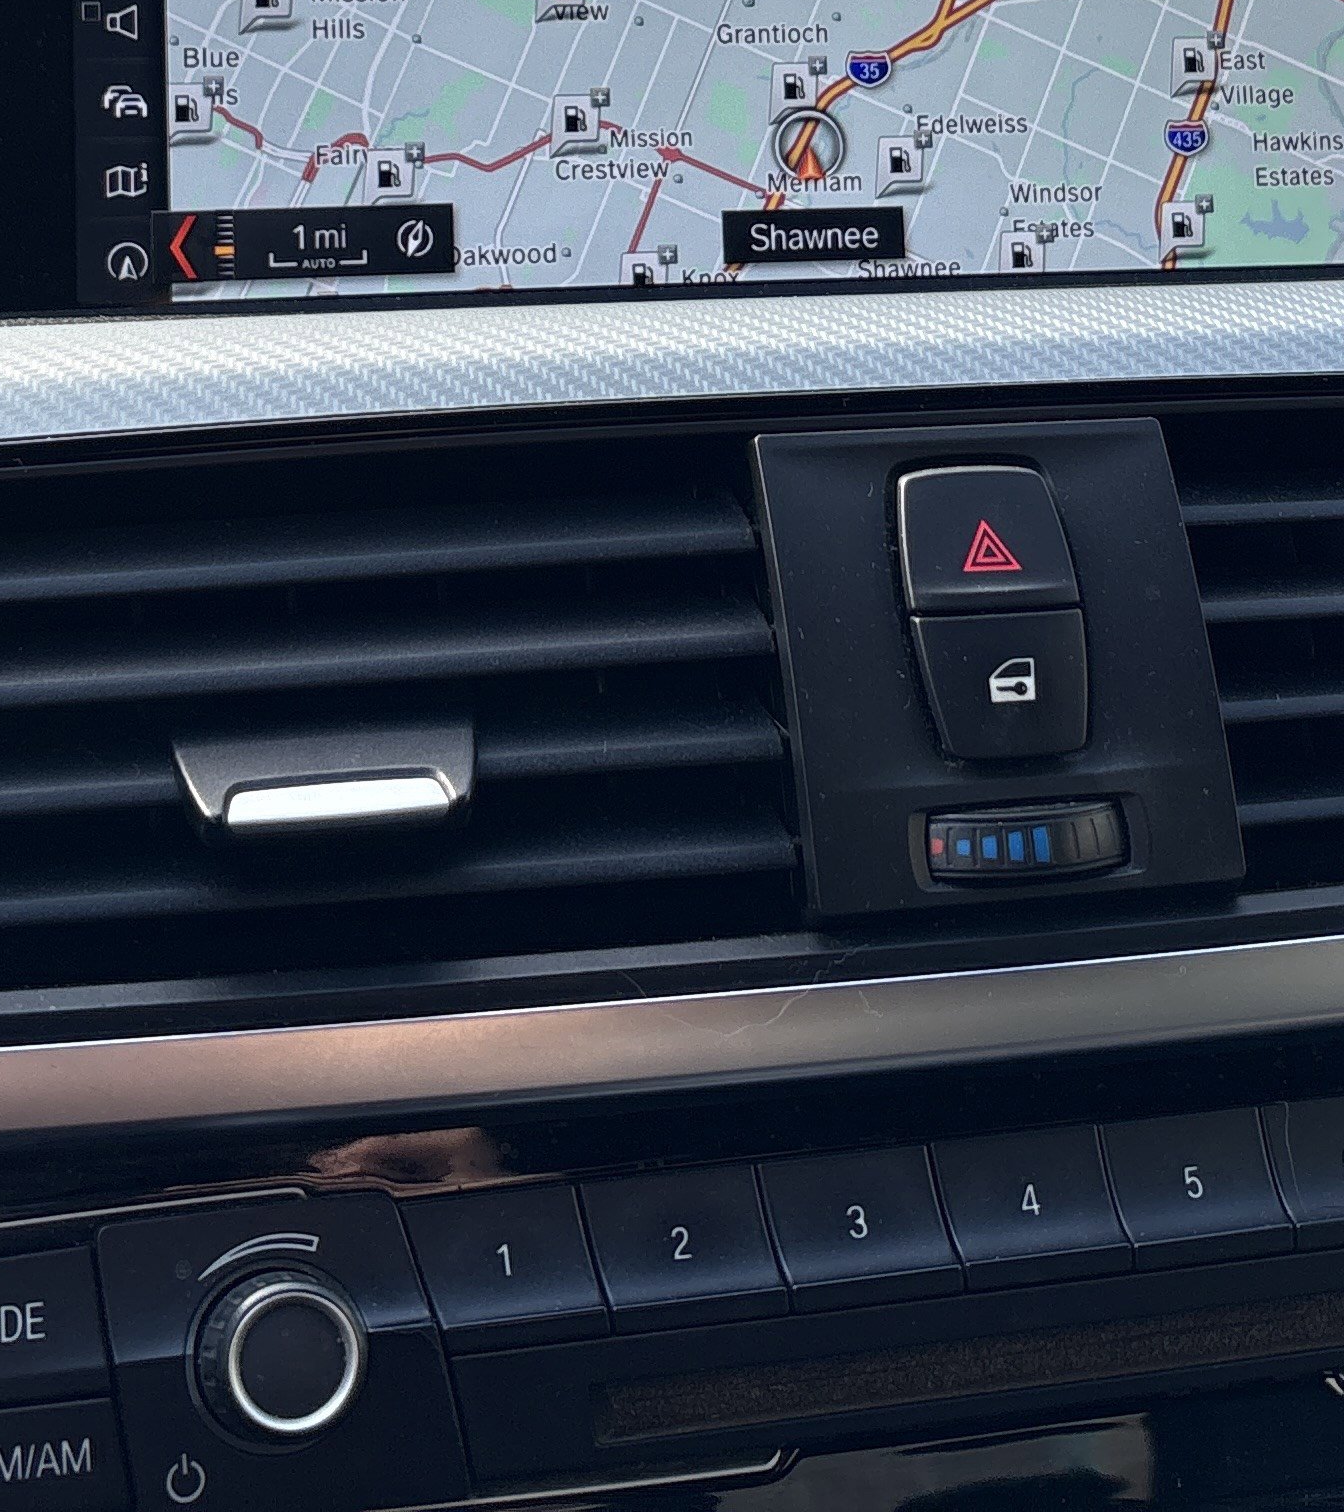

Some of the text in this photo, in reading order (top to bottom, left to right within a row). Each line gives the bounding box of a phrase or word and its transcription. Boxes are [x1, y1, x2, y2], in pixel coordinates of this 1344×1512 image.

[312, 19, 366, 40] Hills
[717, 23, 829, 45] Grantioch
[184, 47, 240, 68] Blue
[1220, 51, 1266, 71] East
[859, 63, 881, 79] 35
[1221, 85, 1295, 108] Village
[916, 114, 1028, 134] Edelweiss
[610, 128, 693, 148] Mission
[1172, 131, 1203, 148] 435
[1253, 131, 1344, 152] Hawkins
[555, 159, 670, 181] Crestview
[1255, 166, 1335, 187] Estates
[1009, 183, 1103, 203] Windsor
[293, 223, 347, 250] 1 mi
[750, 223, 879, 252] Shawnee
[1013, 219, 1095, 238] Esates
[301, 258, 336, 269] AUTO
[857, 259, 961, 278] Shawnee
[1184, 1165, 1203, 1199] 5
[1021, 1184, 1041, 1216] 4
[846, 1204, 868, 1239] 3
[670, 1226, 692, 1261] 2
[496, 1243, 511, 1276] 1
